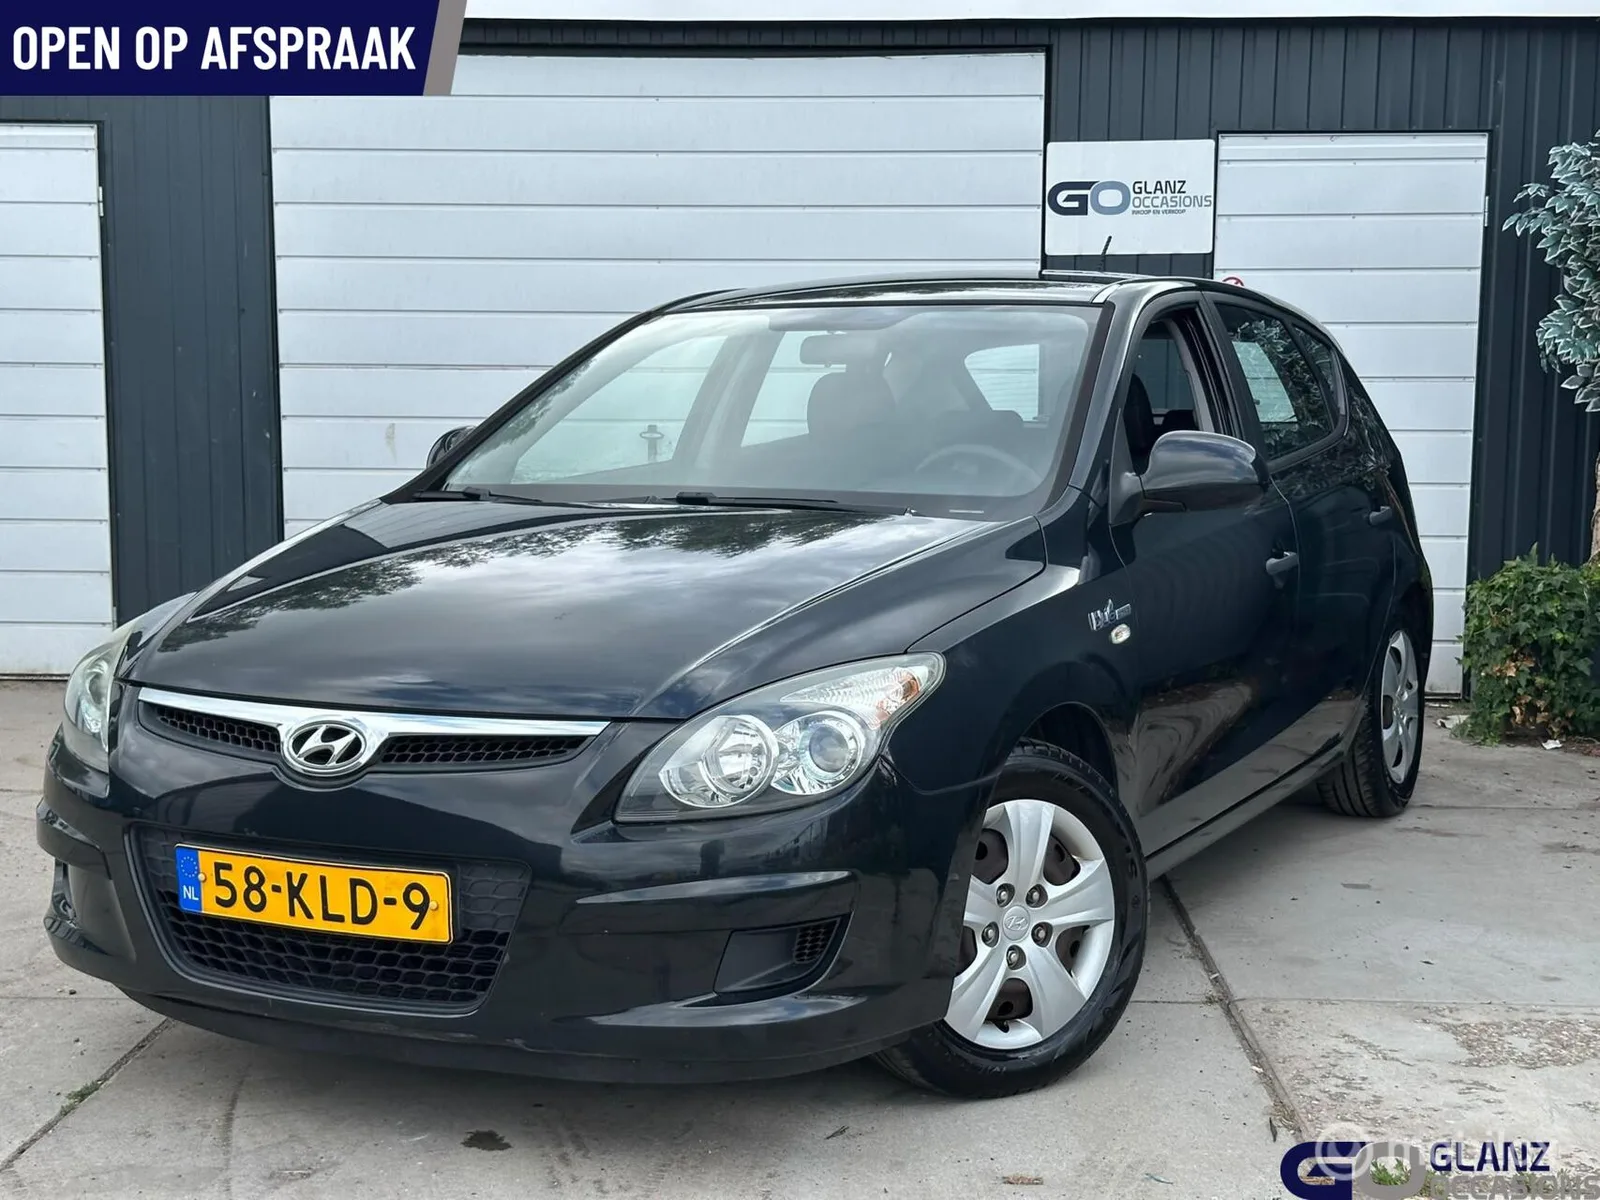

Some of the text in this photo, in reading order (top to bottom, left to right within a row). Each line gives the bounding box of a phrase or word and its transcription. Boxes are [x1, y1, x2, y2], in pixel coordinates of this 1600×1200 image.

[1132, 180, 1187, 195] GLANZ
[1047, 180, 1131, 216] GO
[1131, 195, 1212, 209] OCCASIONS
[183, 885, 199, 901] NL
[213, 861, 431, 930] 58-KLD-9
